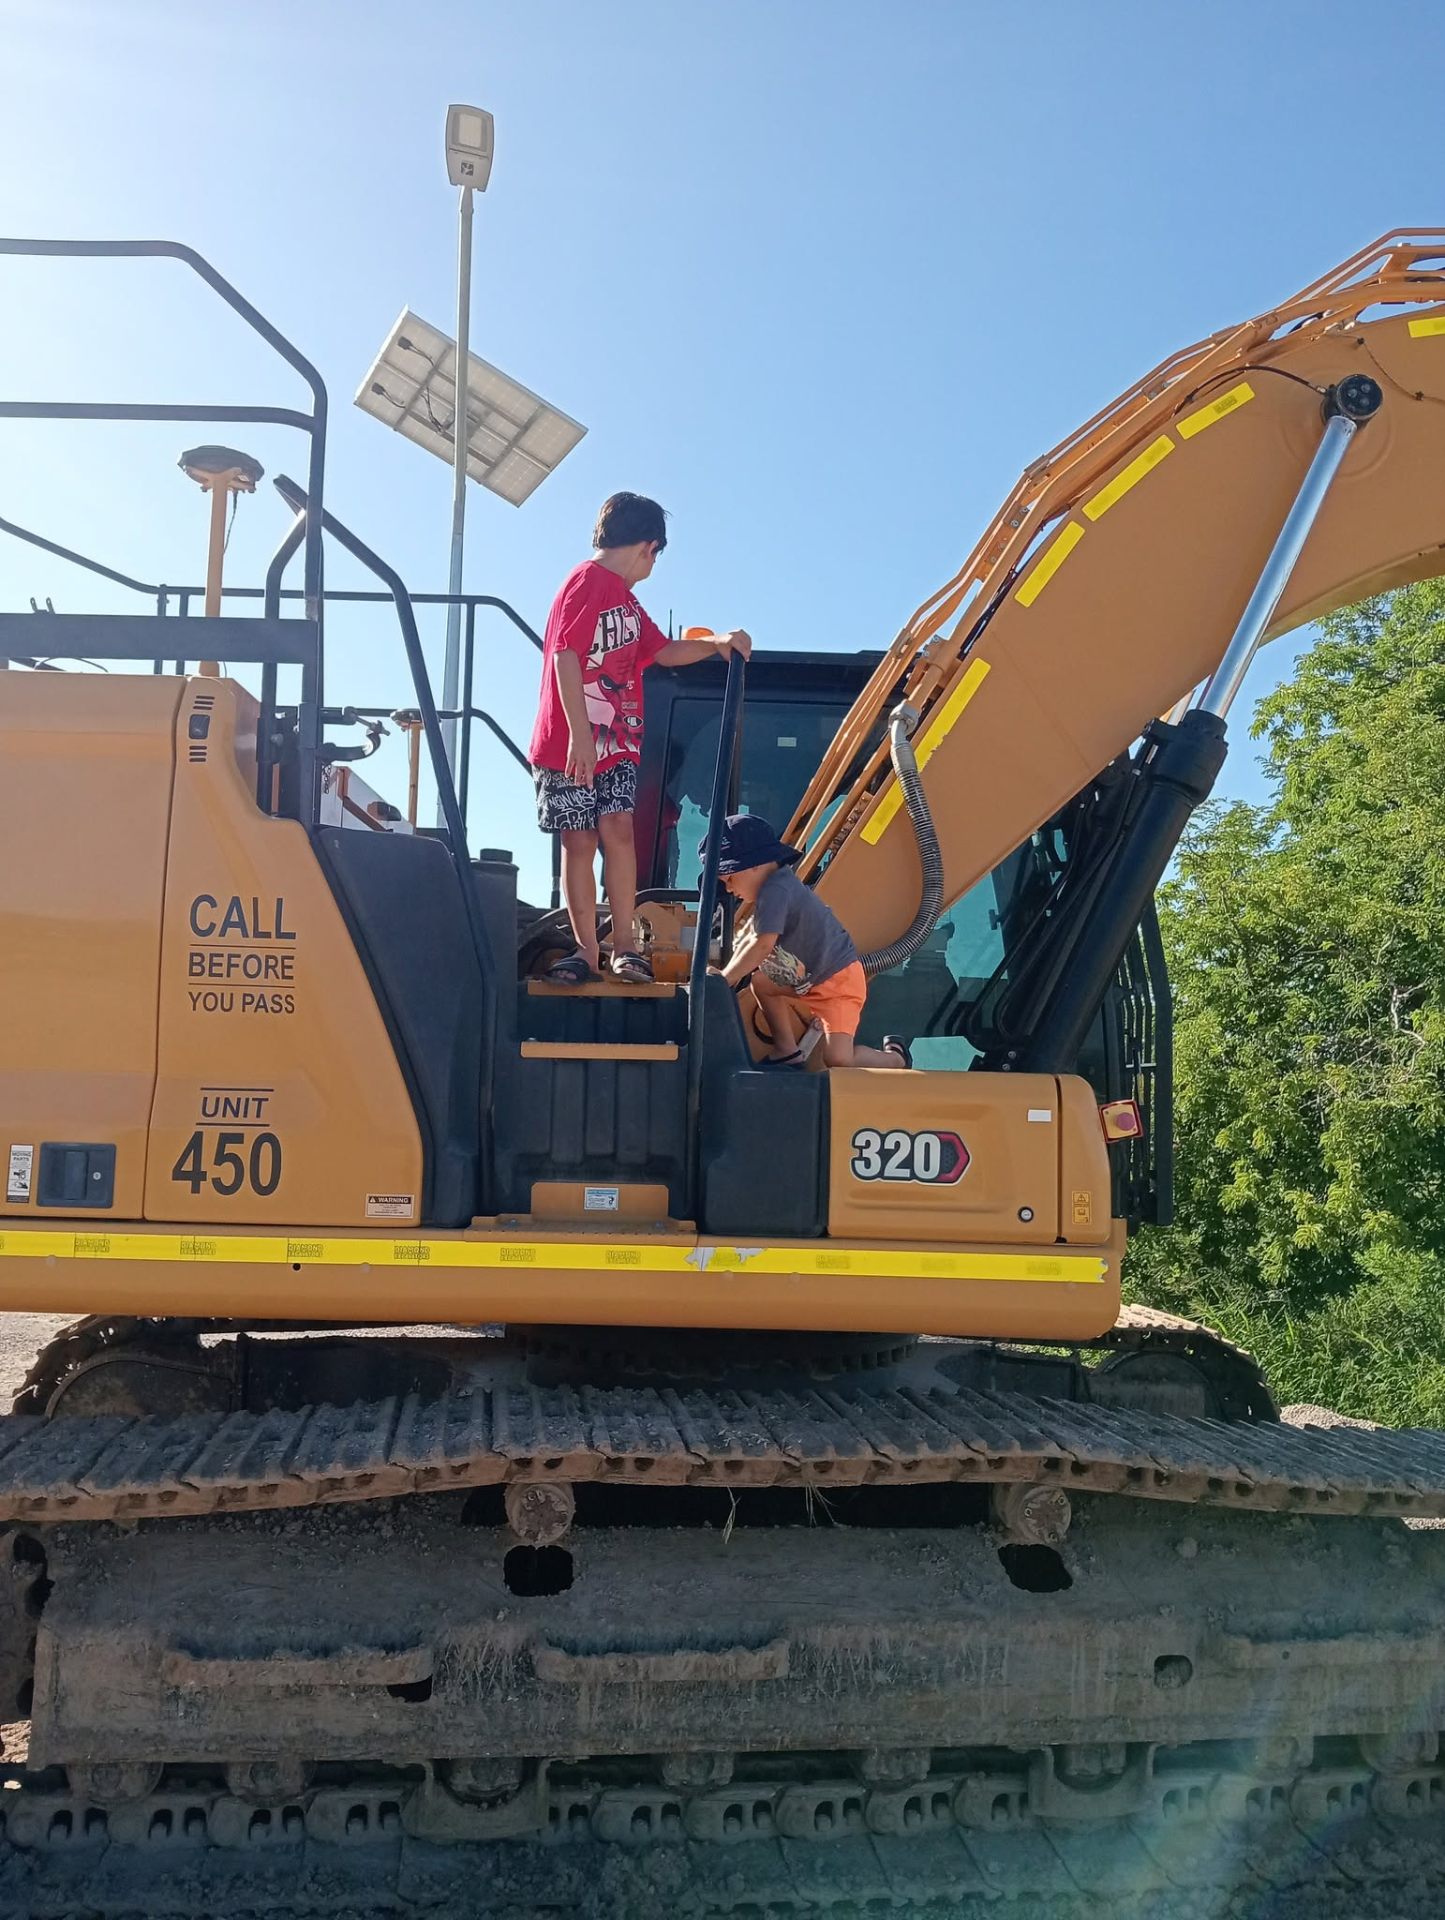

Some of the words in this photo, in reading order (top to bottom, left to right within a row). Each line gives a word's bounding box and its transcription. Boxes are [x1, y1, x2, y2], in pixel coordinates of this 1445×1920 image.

[189, 894, 296, 940] CALL
[188, 952, 295, 980] BEFORE
[188, 991, 234, 1012] YOU
[241, 992, 295, 1014] PASS
[201, 1096, 269, 1118] UNIT
[171, 1130, 282, 1196] 450
[853, 1130, 941, 1180] 320
[377, 1196, 409, 1204] WARNING
[287, 1243, 323, 1251] DIAMOND
[394, 1245, 430, 1253] DIAMOND
